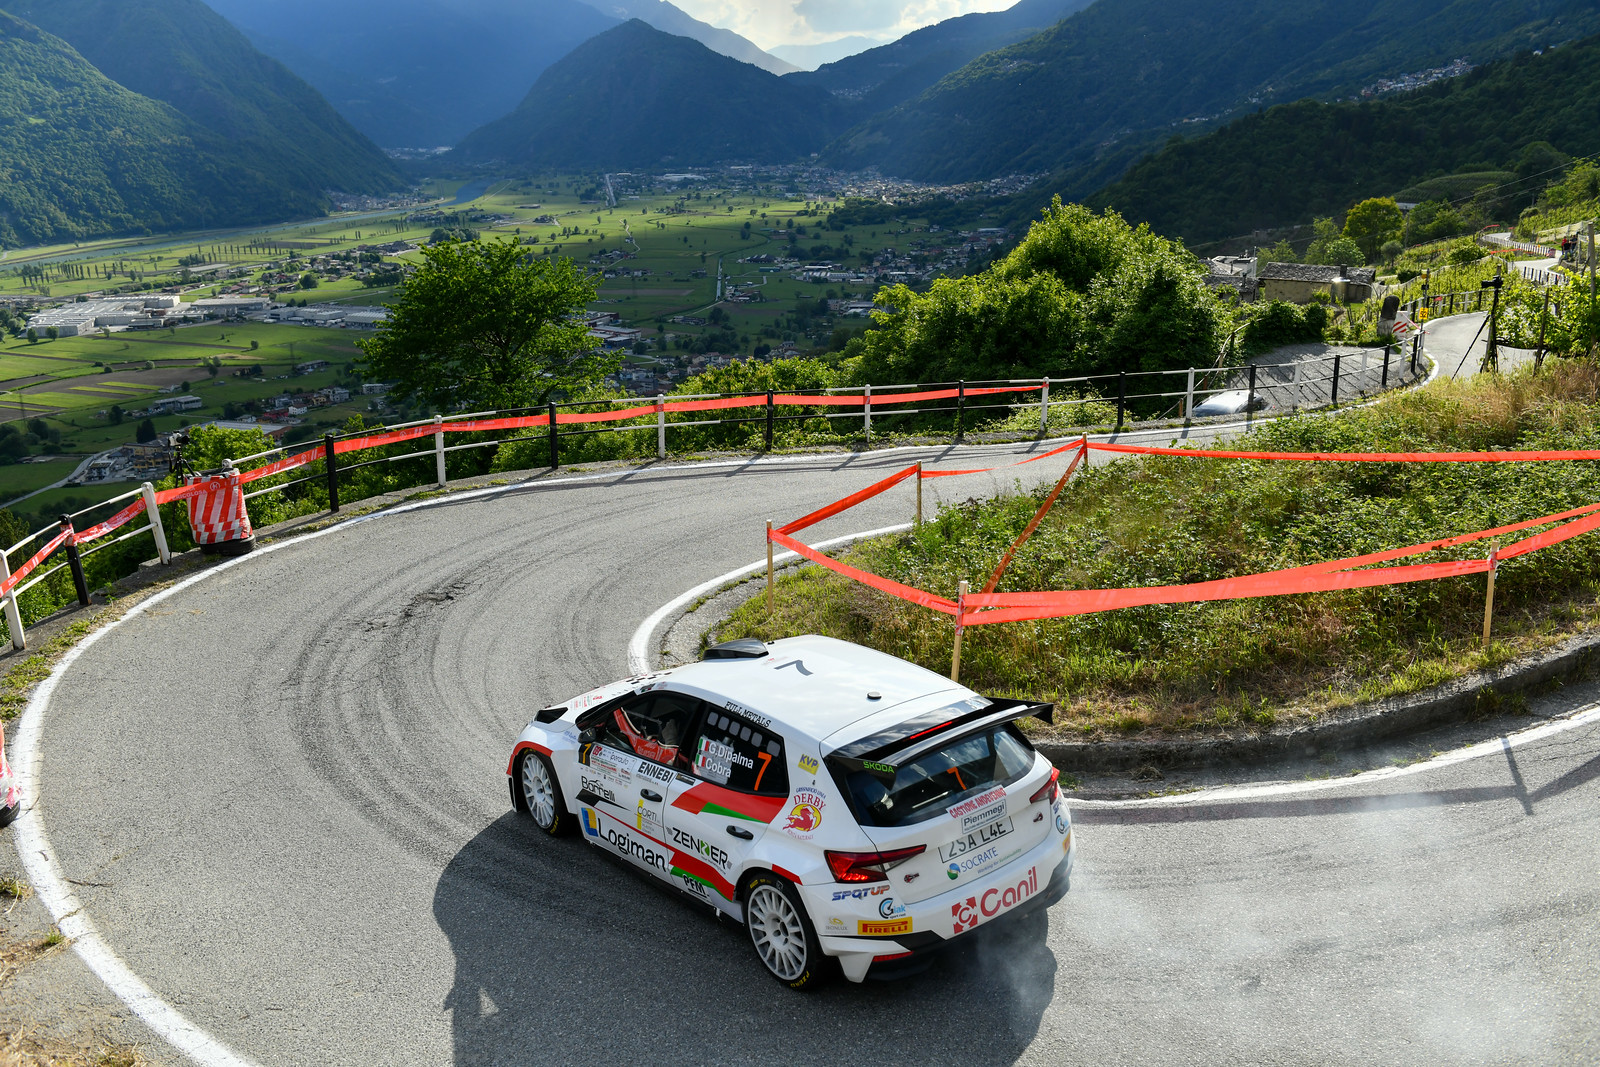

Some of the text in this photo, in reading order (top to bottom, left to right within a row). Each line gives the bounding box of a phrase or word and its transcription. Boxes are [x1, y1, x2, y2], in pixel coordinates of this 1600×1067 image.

[774, 660, 813, 676] 7
[725, 701, 772, 728] FULL METALS
[705, 758, 732, 778] Cobra
[708, 742, 754, 770] G.Dipalma
[799, 754, 819, 768] KVP
[637, 761, 674, 783] ENNEBI
[754, 751, 772, 791] 7
[946, 766, 967, 790] 7
[637, 805, 657, 821] CORTI
[793, 793, 827, 811] DERBY
[949, 787, 1007, 819] CASTIONE ANDEVENNO
[963, 801, 1006, 827] Piemmegi
[597, 817, 666, 872] Logiman
[672, 826, 728, 869] ZENKER
[960, 846, 999, 873] SOCRATE
[683, 874, 706, 895] PFM
[831, 884, 890, 901] SPOTUP
[980, 866, 1038, 917] Canil
[862, 920, 908, 933] PIRELLI
